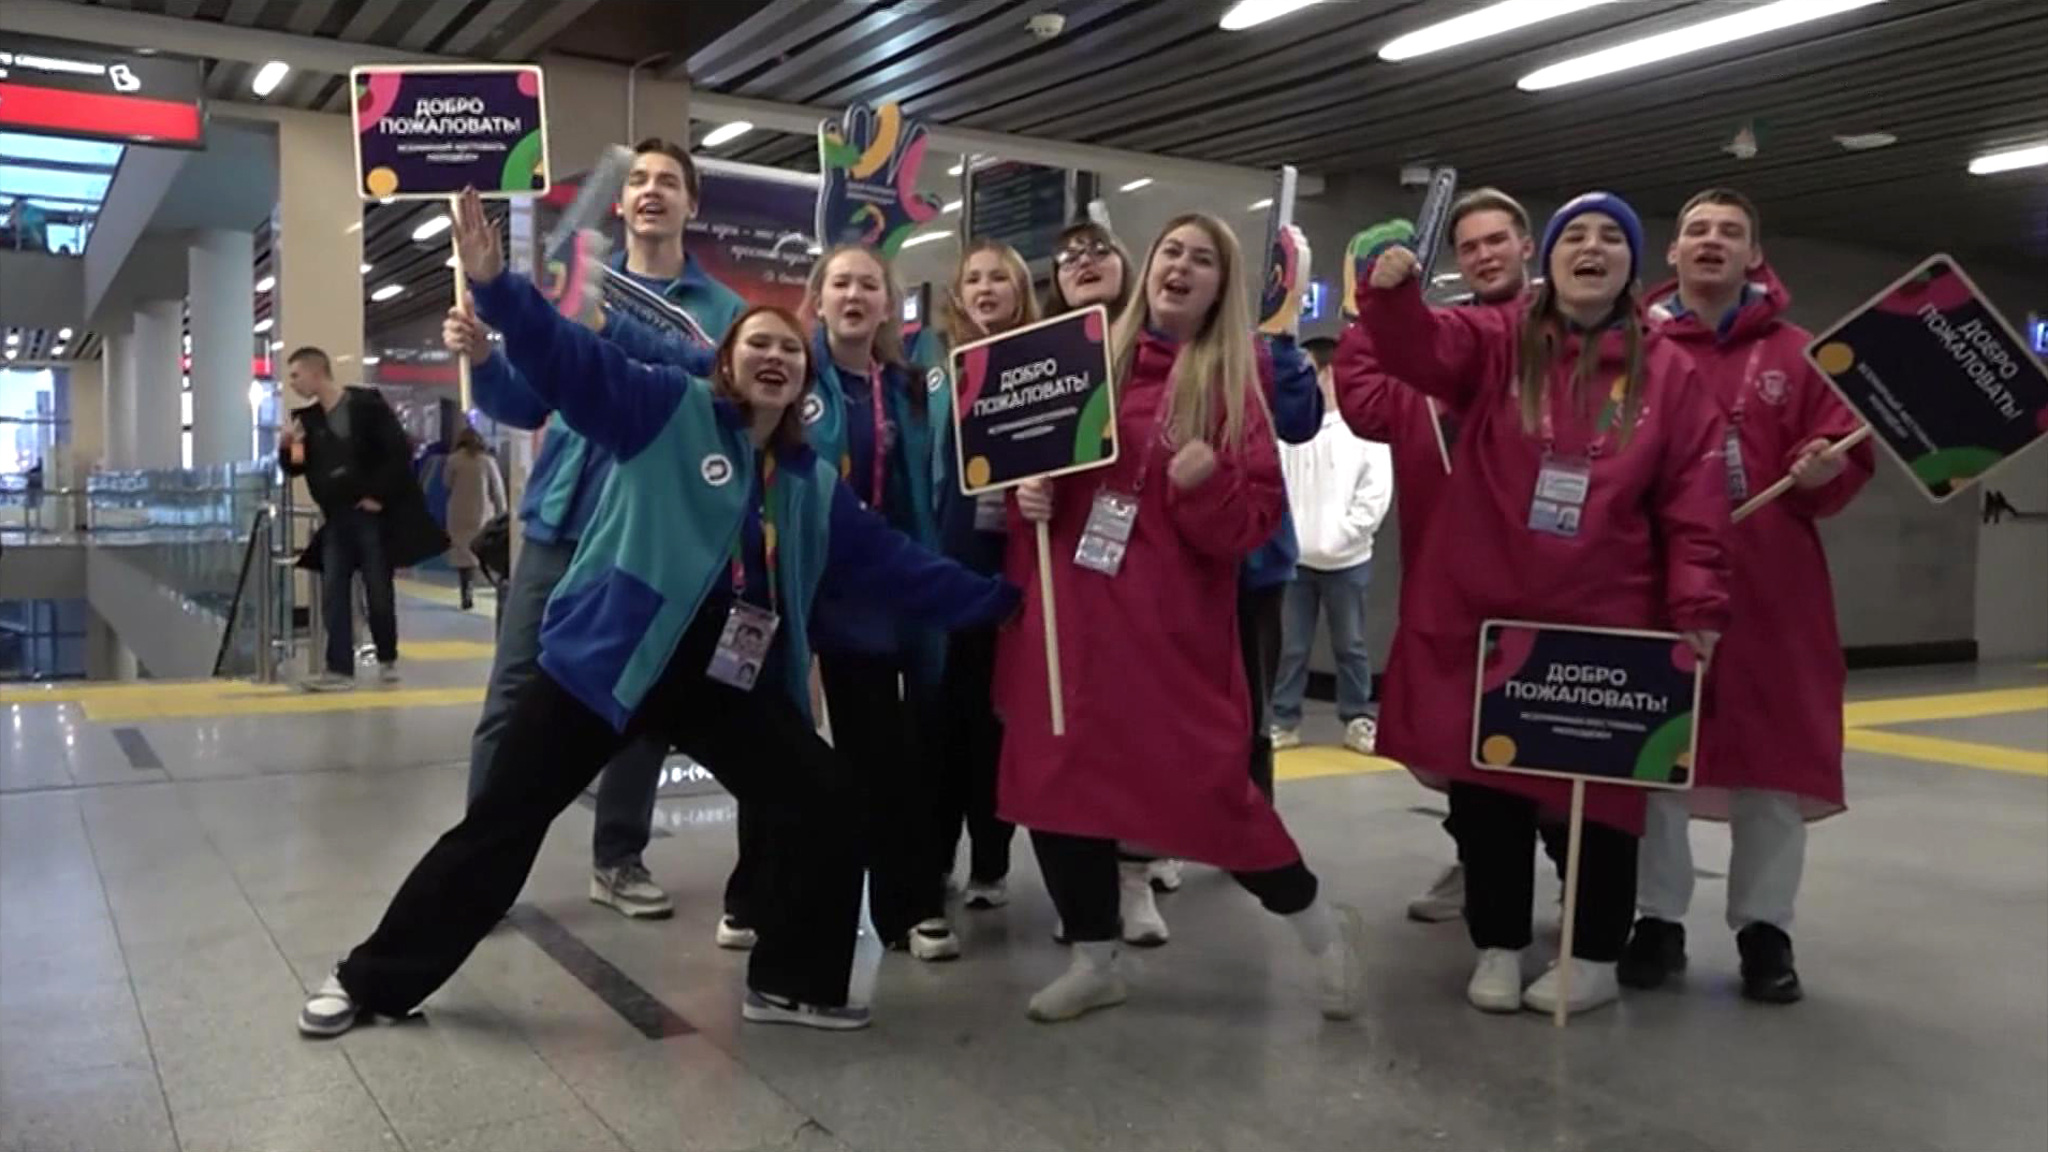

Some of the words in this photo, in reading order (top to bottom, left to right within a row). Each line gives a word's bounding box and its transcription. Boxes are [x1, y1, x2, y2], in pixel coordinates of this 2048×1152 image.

[415, 97, 485, 117] ДОБРО
[380, 117, 522, 135] ПОЖАЛОВАТЬ!
[1917, 303, 2024, 421] ПОЖАЛОВАТЬ!
[1959, 318, 2020, 380] ДОБРО
[1000, 358, 1057, 392] ДОБРО
[974, 371, 1090, 417] ПОЖАЛОВАТЬ!
[1546, 663, 1627, 686] ДОБРО
[1505, 681, 1668, 713] ПОЖАЛОВАТЬ!
